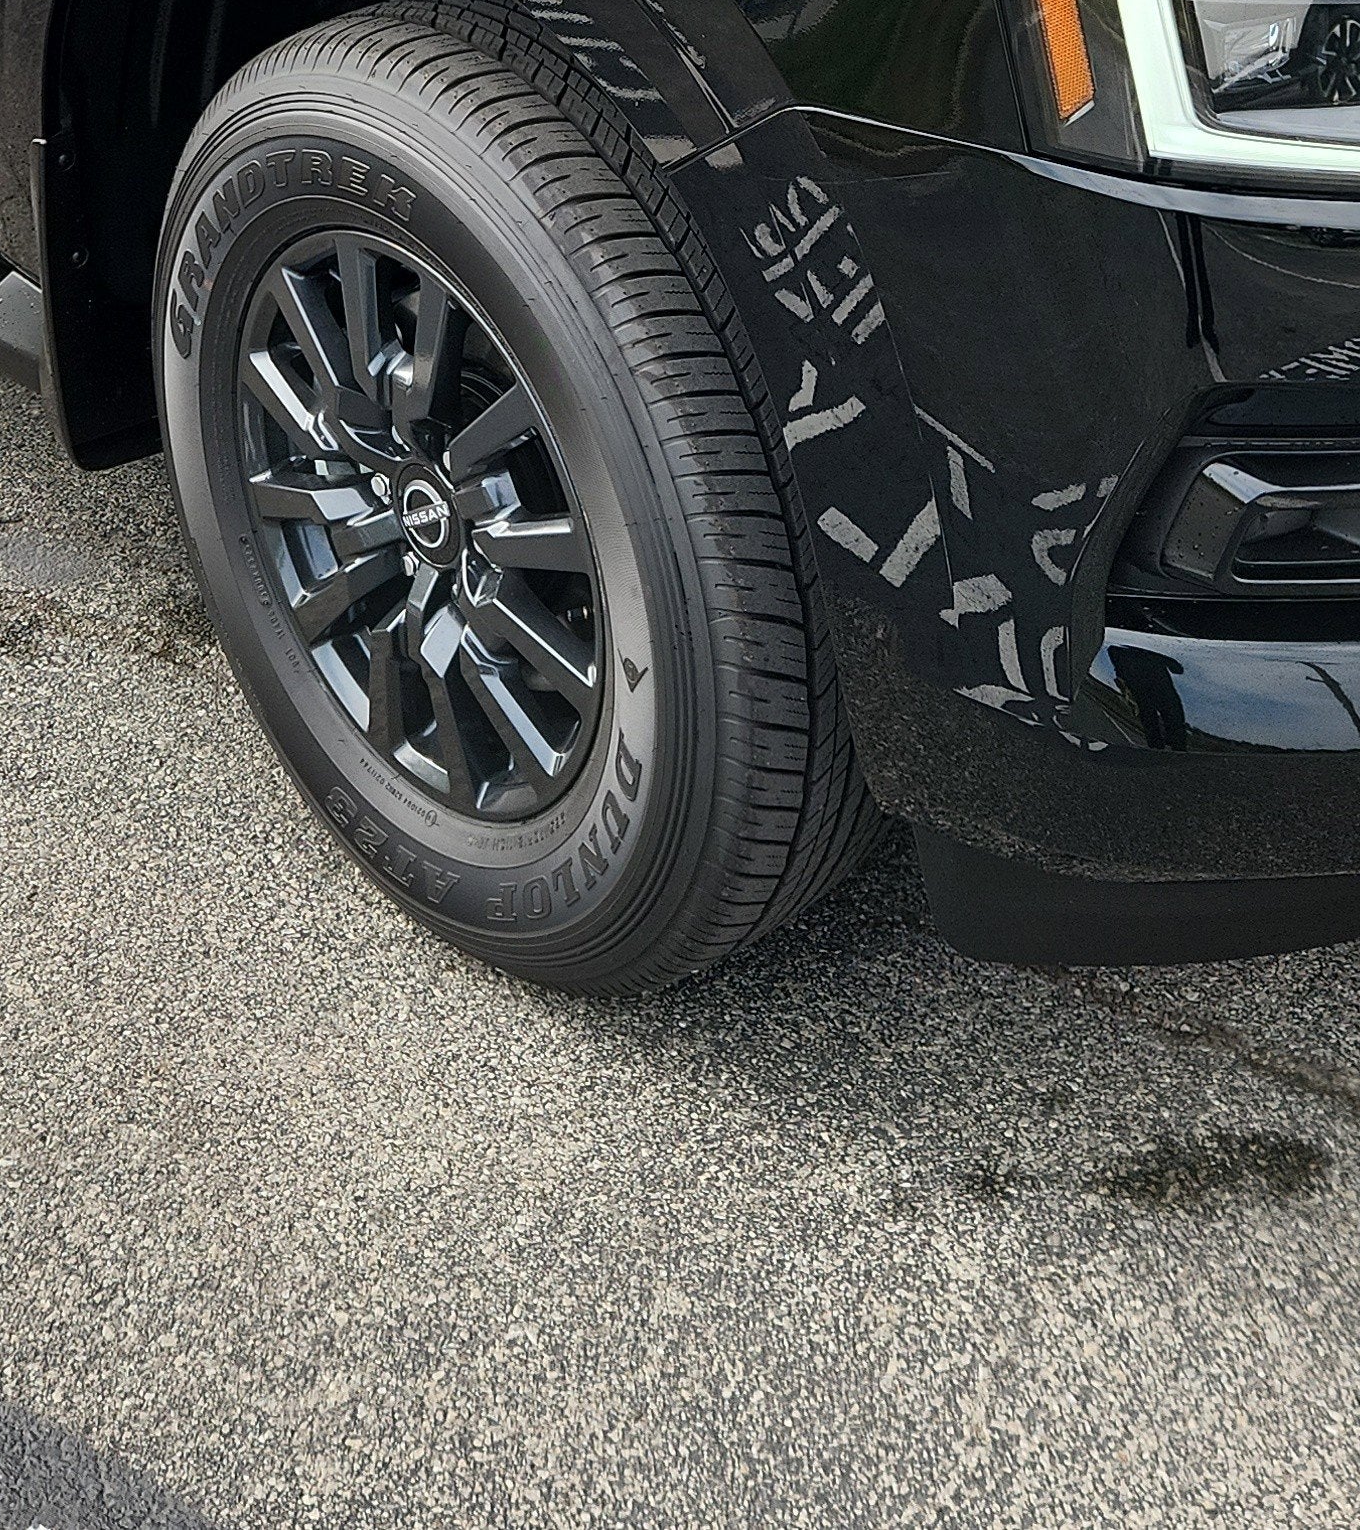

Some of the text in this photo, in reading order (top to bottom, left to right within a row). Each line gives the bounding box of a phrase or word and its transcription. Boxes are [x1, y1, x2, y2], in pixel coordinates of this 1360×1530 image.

[169, 147, 418, 360] GRANDTREK
[402, 504, 451, 527] NISSAN
[483, 725, 643, 923] DUNLOP
